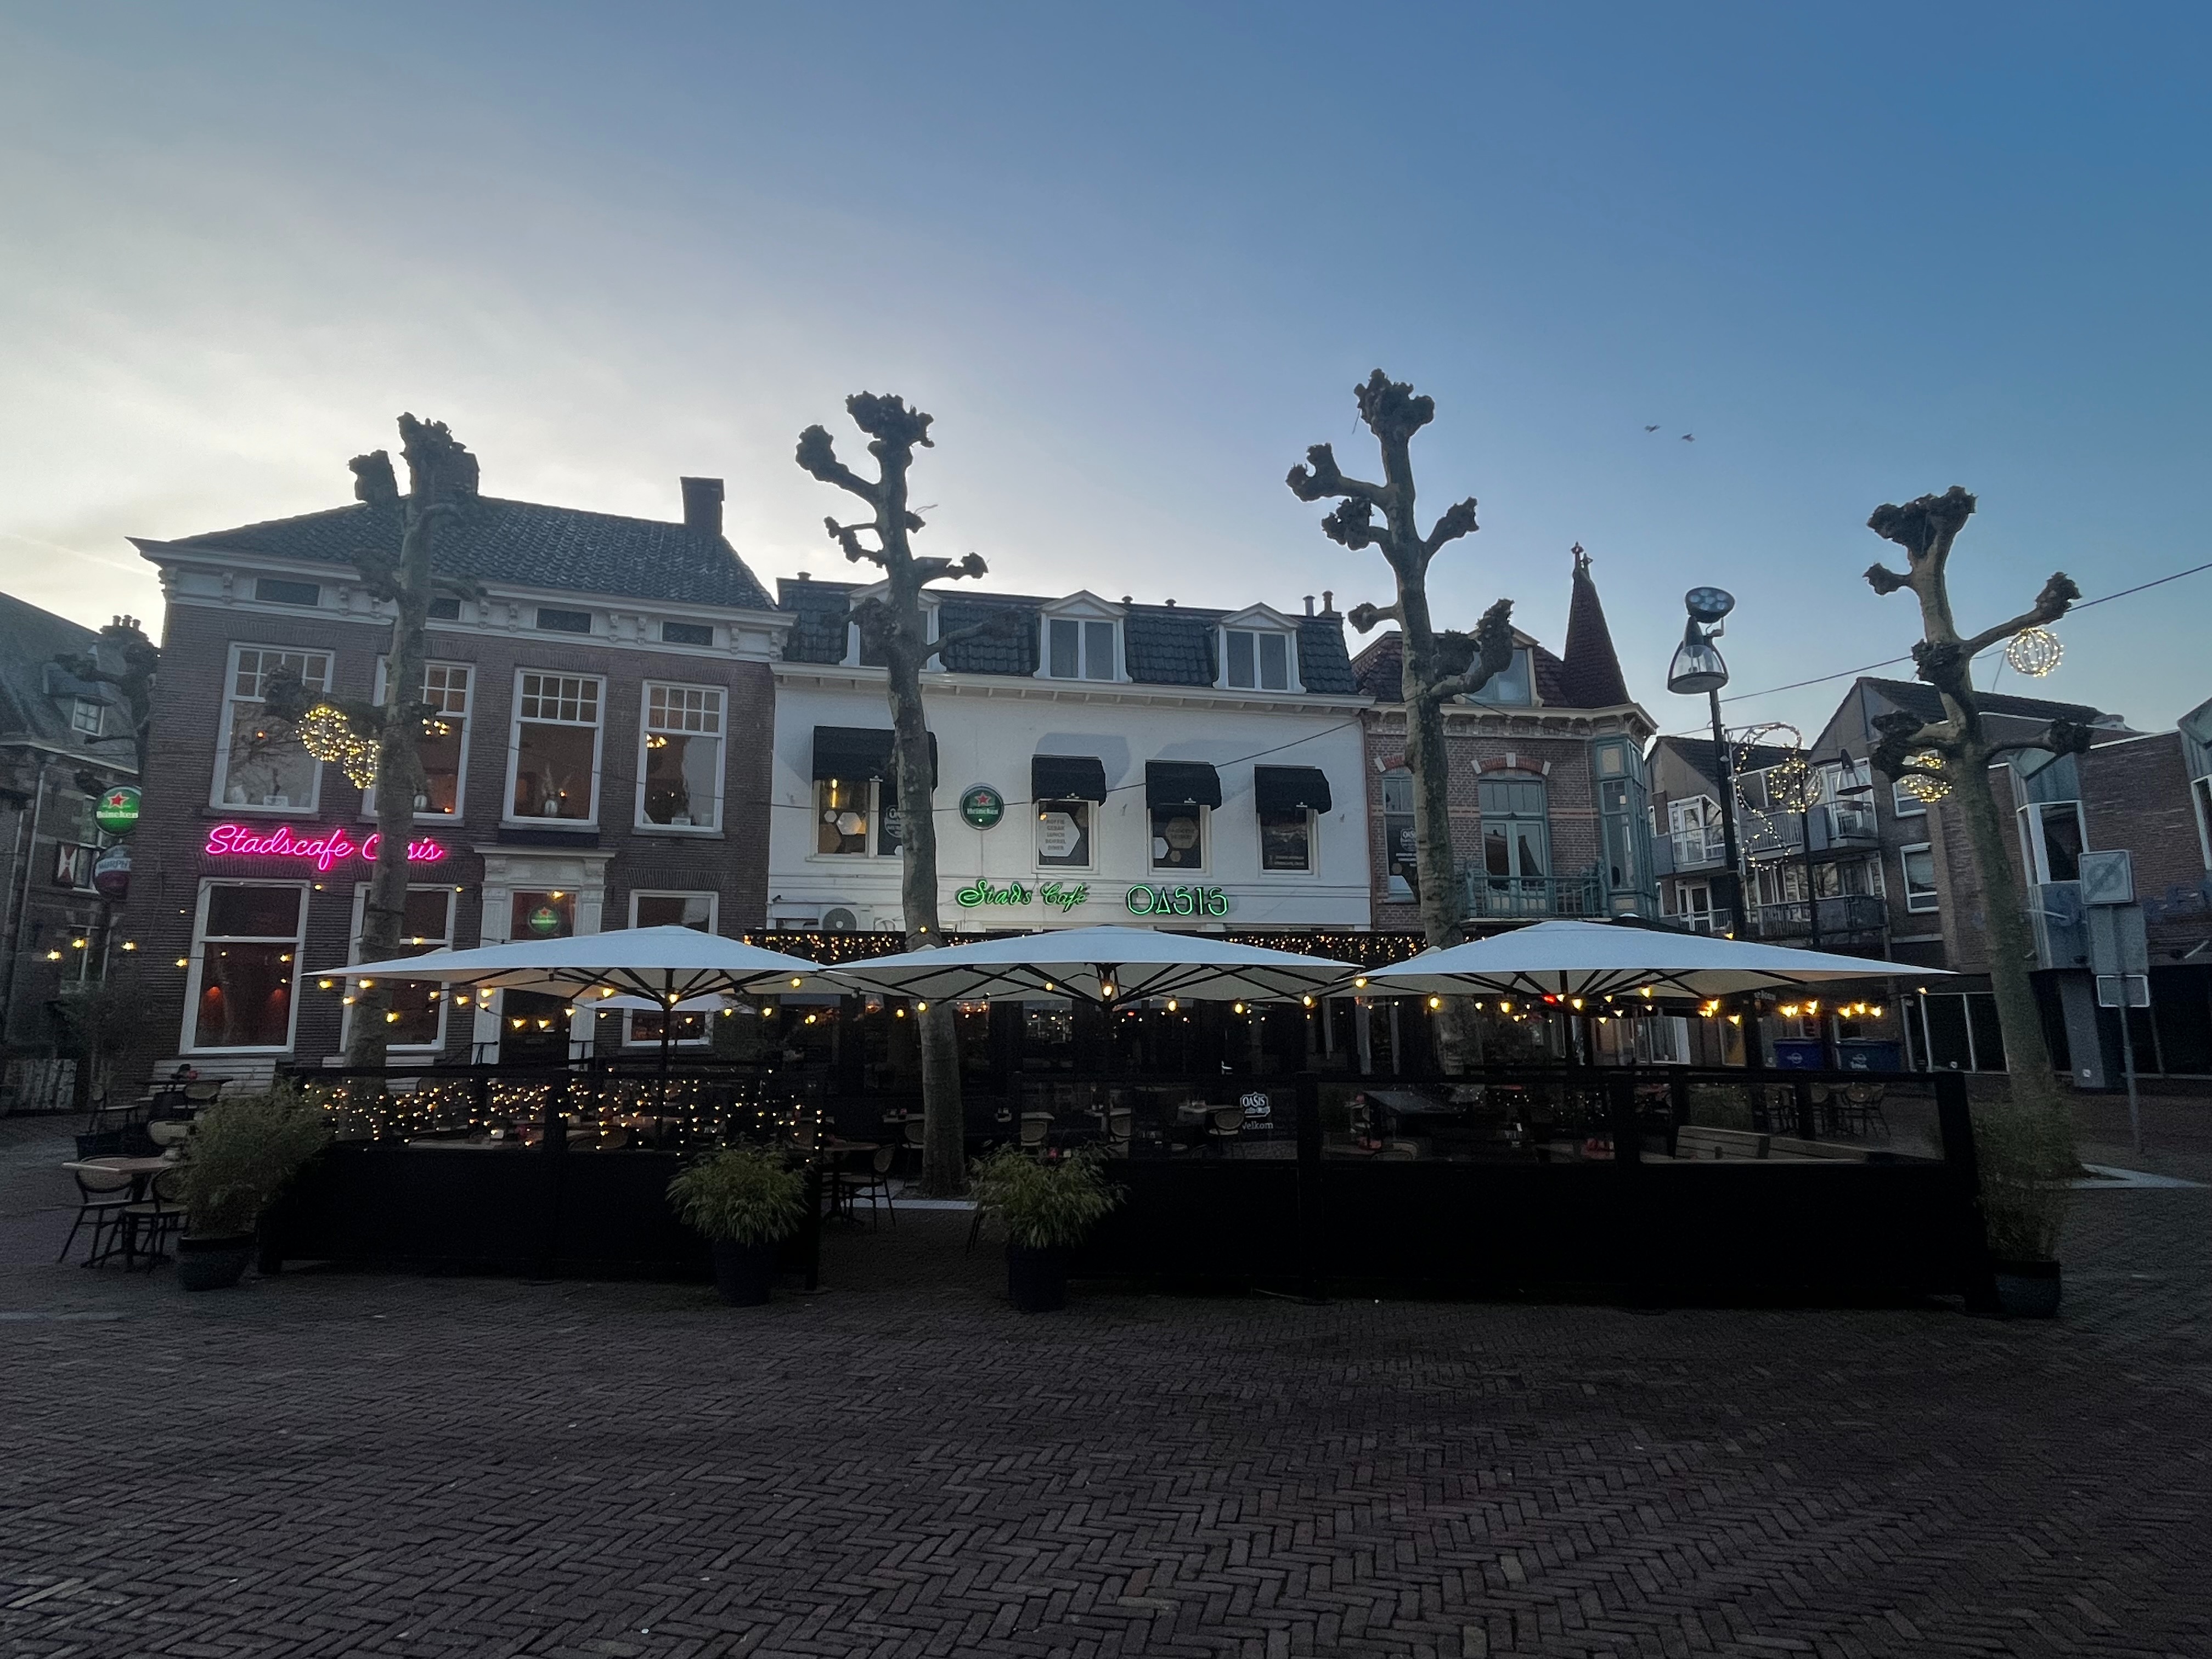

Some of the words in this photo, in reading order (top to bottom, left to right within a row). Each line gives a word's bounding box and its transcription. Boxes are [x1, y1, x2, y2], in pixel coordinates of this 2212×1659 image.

[206, 824, 354, 872] Stadscafe
[955, 879, 1034, 907] Stads
[1126, 884, 1229, 916] OASIS
[1243, 1096, 1265, 1107] OASIS
